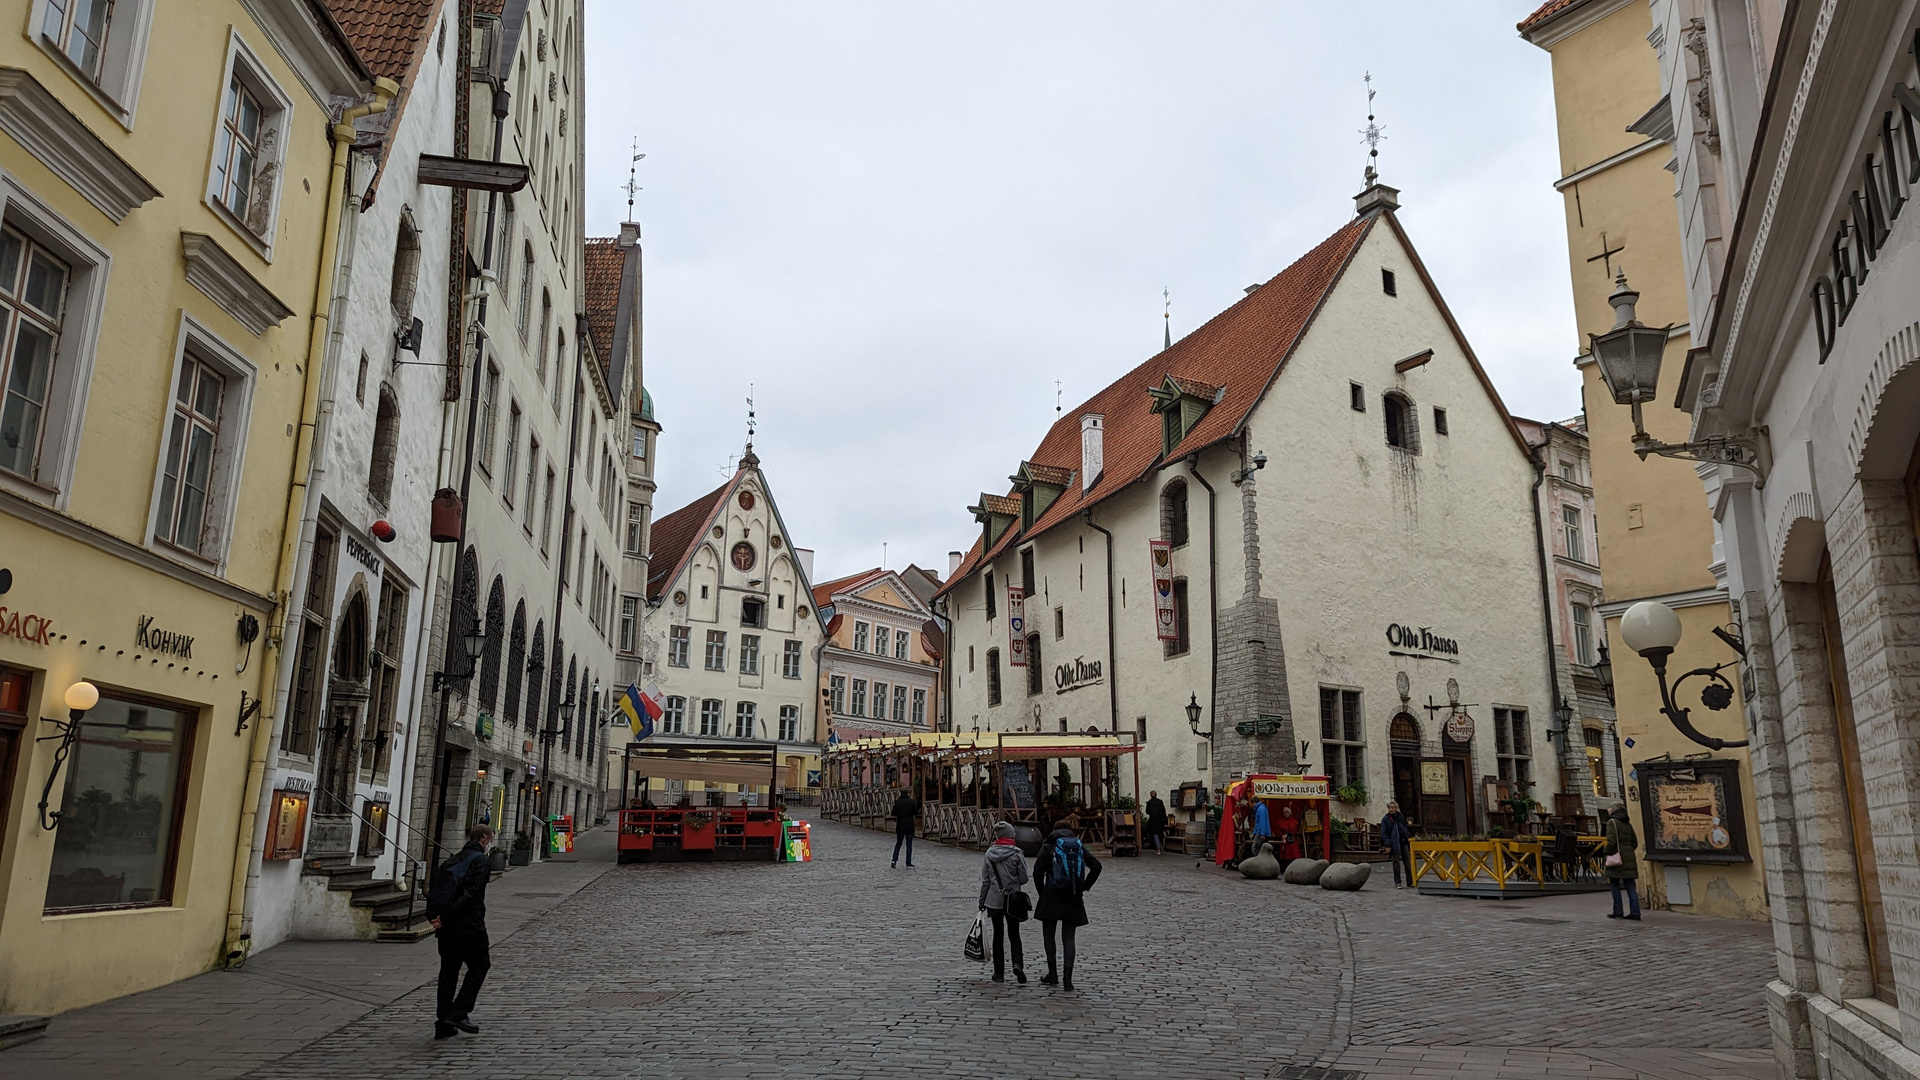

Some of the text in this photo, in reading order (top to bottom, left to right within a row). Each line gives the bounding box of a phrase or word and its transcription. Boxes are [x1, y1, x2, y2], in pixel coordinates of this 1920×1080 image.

[1385, 622, 1419, 648] Olde
[1055, 664, 1075, 689] Olde
[1264, 783, 1285, 793] Olde
[551, 834, 573, 849] -30%
[787, 841, 810, 858] -30%
